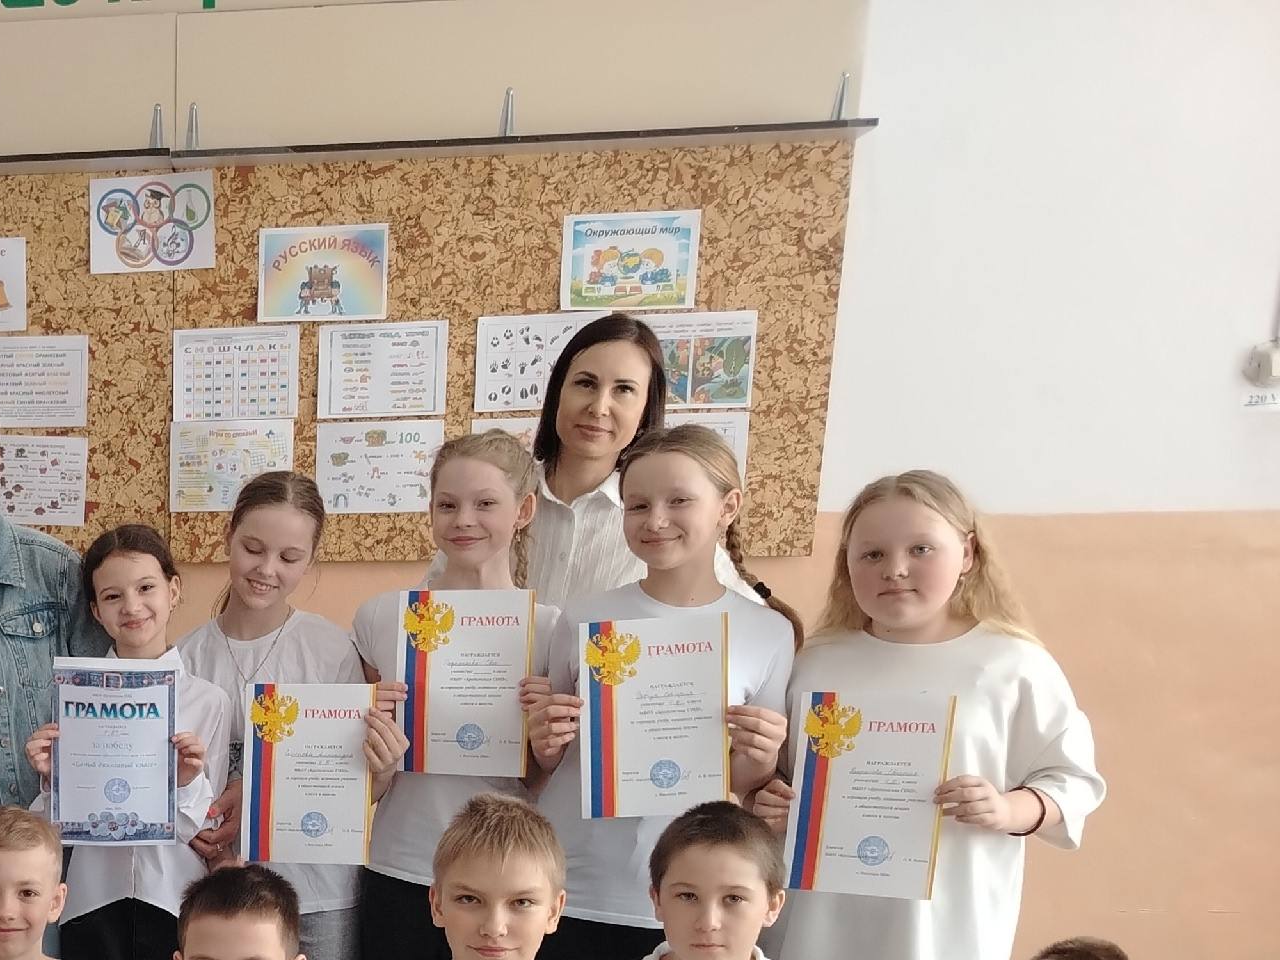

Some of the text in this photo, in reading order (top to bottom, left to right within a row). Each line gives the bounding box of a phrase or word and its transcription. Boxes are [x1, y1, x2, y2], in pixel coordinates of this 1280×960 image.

[585, 225, 681, 238] Окружающий мир
[272, 235, 381, 272] РУССКИЙ ЯЗЫК
[460, 616, 520, 626] ГРАМОТА
[647, 641, 713, 656] ГРАМОТА
[64, 701, 160, 718] ГРАМОТА
[304, 709, 361, 719] ГРАМОТА
[868, 721, 936, 733] ГРАМОТА
